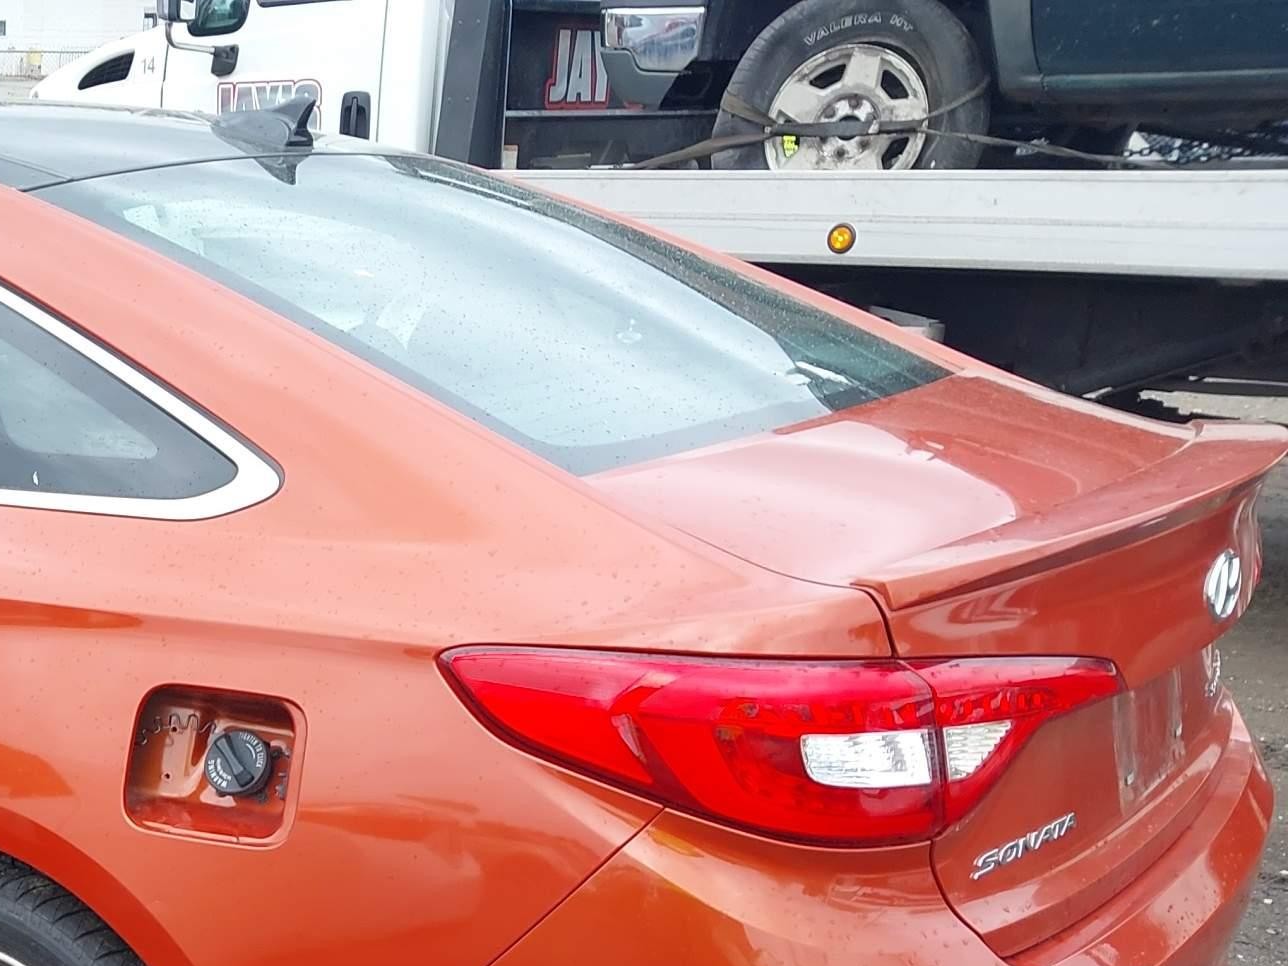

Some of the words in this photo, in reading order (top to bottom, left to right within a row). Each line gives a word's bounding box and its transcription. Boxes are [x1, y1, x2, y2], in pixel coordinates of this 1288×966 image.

[803, 12, 882, 46] VALERA
[140, 55, 155, 75] 14
[548, 28, 609, 104] JAY
[969, 812, 1076, 880] SONATA
